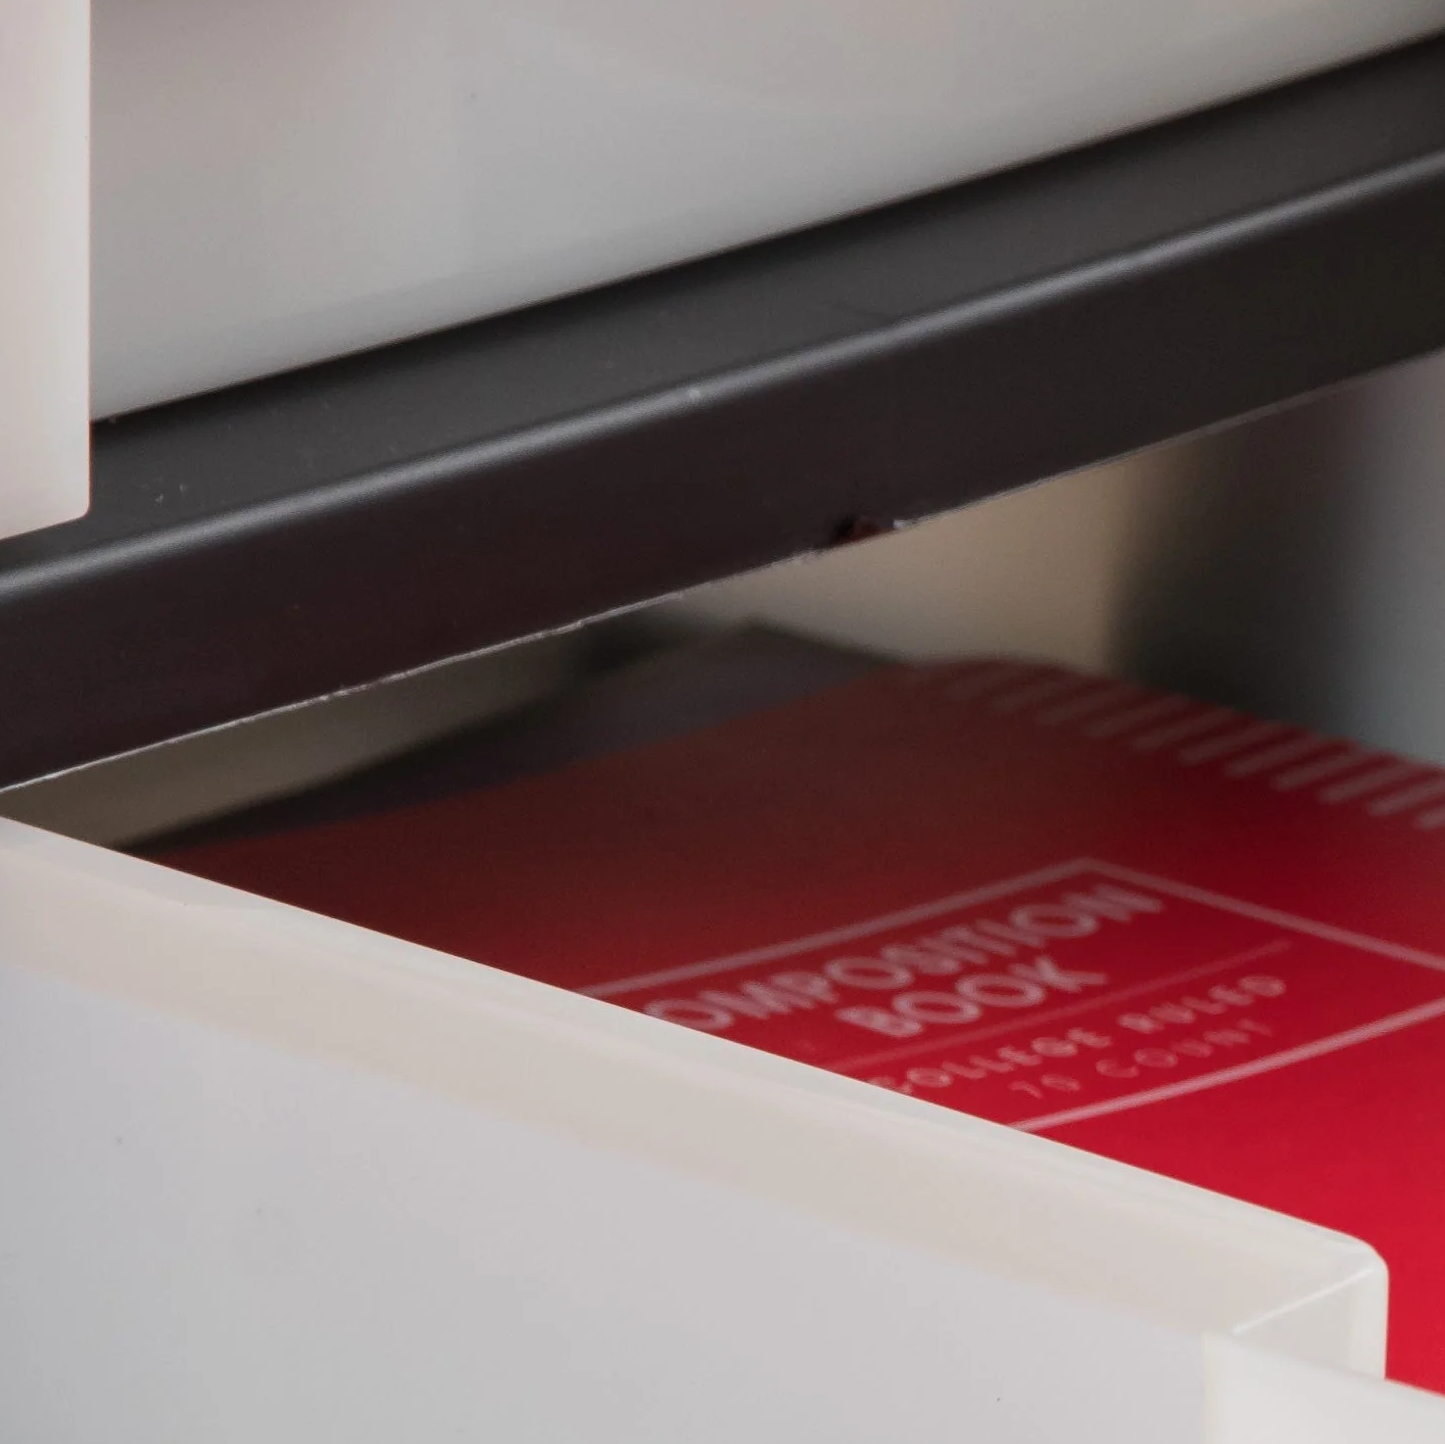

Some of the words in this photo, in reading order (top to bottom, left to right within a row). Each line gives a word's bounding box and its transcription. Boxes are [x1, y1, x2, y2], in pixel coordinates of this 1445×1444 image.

[644, 883, 1163, 1030] OMPOSITION
[834, 956, 1109, 1038] BOOK
[1115, 975, 1286, 1034] RULED
[1094, 1018, 1273, 1079] COUNT
